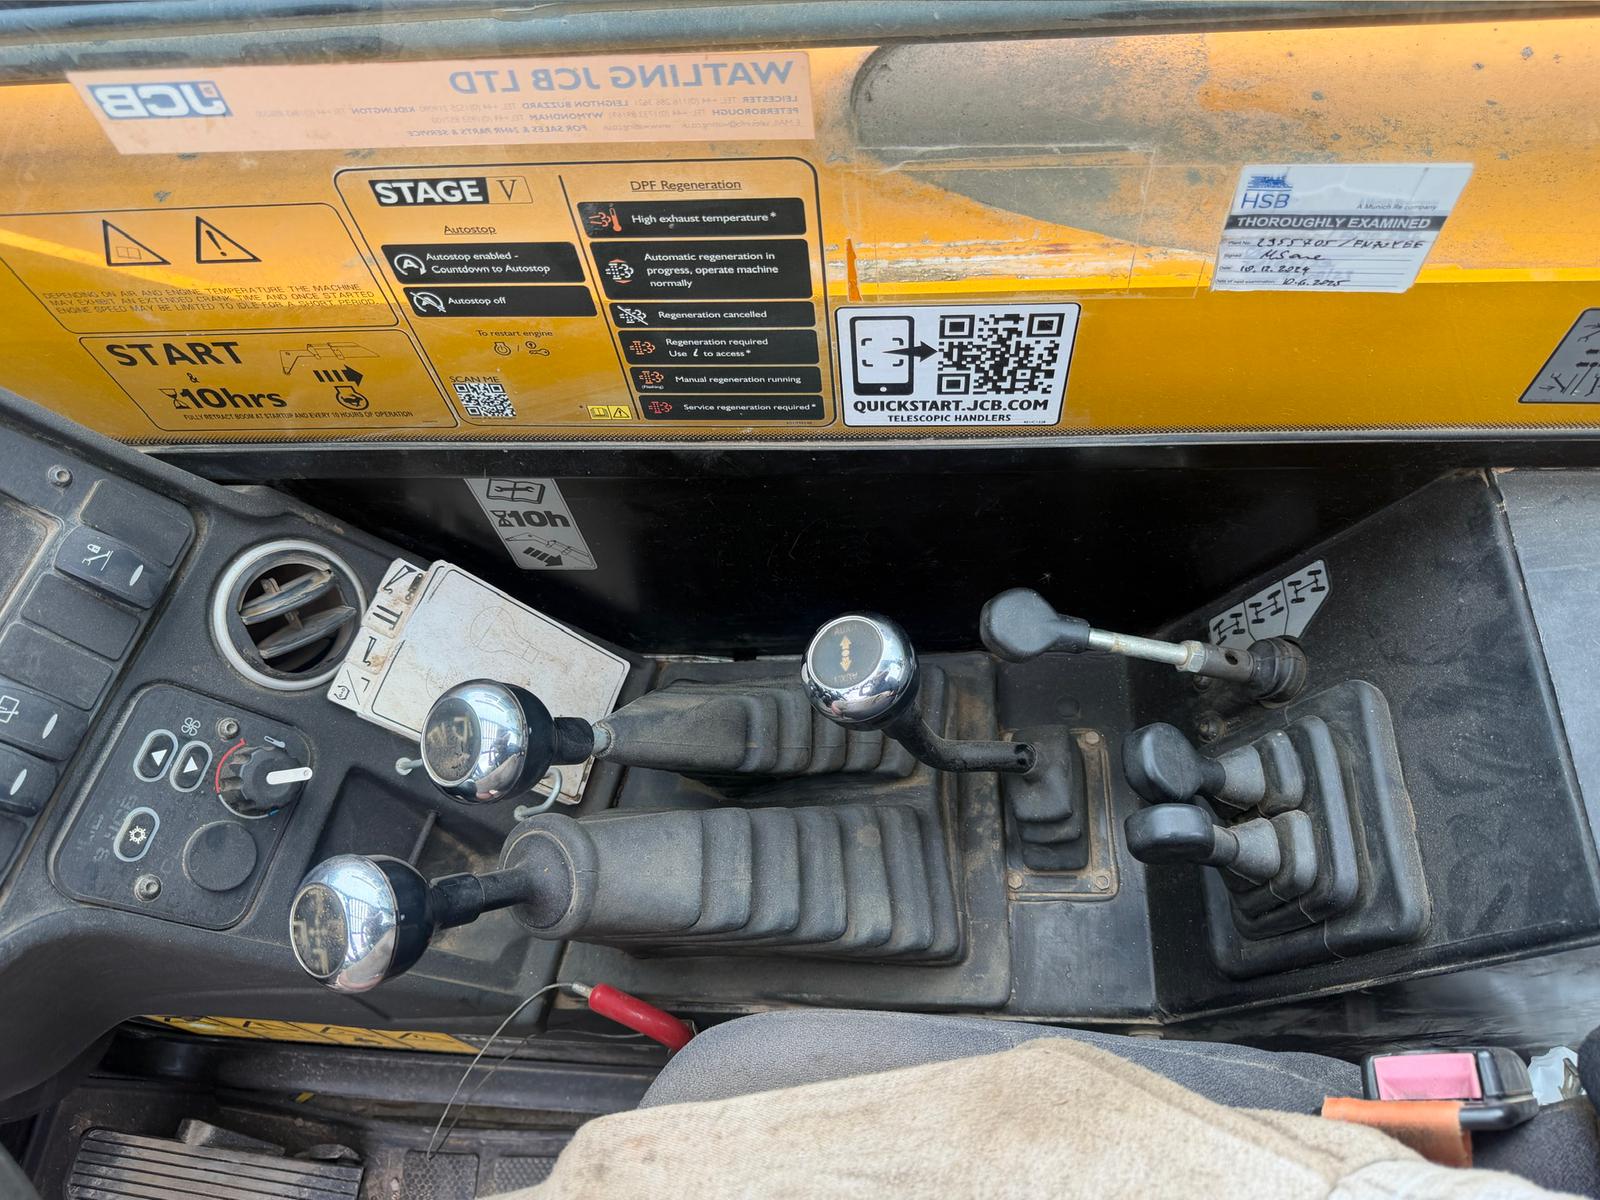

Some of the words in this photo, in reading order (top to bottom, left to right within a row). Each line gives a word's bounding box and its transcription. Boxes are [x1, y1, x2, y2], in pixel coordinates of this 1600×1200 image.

[374, 180, 484, 204] STAGE
[498, 179, 517, 201] V
[630, 181, 657, 192] DPF
[661, 180, 742, 192] Regeneration
[1240, 192, 1291, 209] HSB
[631, 214, 657, 225] High
[659, 213, 700, 223] exhaust
[1237, 217, 1345, 229] THOROUGHLY
[1346, 217, 1432, 229] EXAMINED
[444, 225, 497, 235] Autostop
[426, 253, 471, 263] Autostop
[473, 252, 512, 261] enabled
[644, 253, 697, 262] Automatic
[699, 252, 763, 263] regeneration
[765, 252, 776, 261] in
[431, 264, 490, 274] Countdown
[492, 265, 503, 273] to
[505, 264, 551, 275] Autostop
[647, 266, 693, 277] progress,
[695, 265, 735, 276] operate
[737, 265, 779, 275] machine
[650, 278, 693, 288] normally
[42, 291, 94, 300] DEPENDING
[120, 290, 136, 298] AIR
[141, 289, 164, 297] AND
[165, 288, 201, 297] ENGINE
[205, 286, 287, 295] TEMPERATURE
[288, 285, 312, 293] THE
[312, 283, 362, 292] MACHINE
[49, 299, 74, 307] MAY
[76, 298, 115, 306] EXHIBIT
[121, 297, 136, 305] AN
[137, 296, 198, 304] EXTENDED
[199, 295, 232, 303] CRANK
[236, 293, 261, 301] TIME
[266, 293, 288, 301] AND
[291, 292, 321, 300] ONCE
[324, 290, 375, 299] STARTED
[448, 296, 492, 306] Autostop
[493, 296, 507, 305] off
[56, 306, 91, 314] ENGINE
[95, 305, 128, 313] SPEED
[131, 304, 154, 313] MAY
[159, 304, 174, 312] BE
[175, 303, 215, 312] LIMITED
[221, 302, 234, 310] TO
[237, 301, 261, 309] IDLE
[262, 301, 286, 309] FOR
[298, 299, 334, 308] SHORT
[658, 311, 721, 321] Regeneration
[723, 310, 768, 319] cancelled
[476, 329, 488, 338] To
[490, 330, 521, 338] restart
[523, 330, 554, 339] engine
[665, 337, 727, 347] Regeneration
[728, 337, 769, 347] required
[105, 341, 243, 367] START
[669, 350, 688, 358] Use
[187, 372, 200, 383] &
[449, 375, 480, 384] SCAN
[483, 375, 503, 384] ME
[675, 375, 707, 384] Manual
[709, 375, 766, 385] regeneration
[767, 375, 802, 385] running
[182, 388, 288, 409] 10hrs
[683, 403, 715, 412] Service
[717, 403, 772, 413] regeneration
[852, 398, 1049, 413] QUICKSTART.JCB.COM
[183, 413, 204, 421] FULLY
[888, 414, 951, 423] TELESCOPIC
[954, 414, 1012, 423] HANDLERS
[507, 510, 571, 528] 10h
